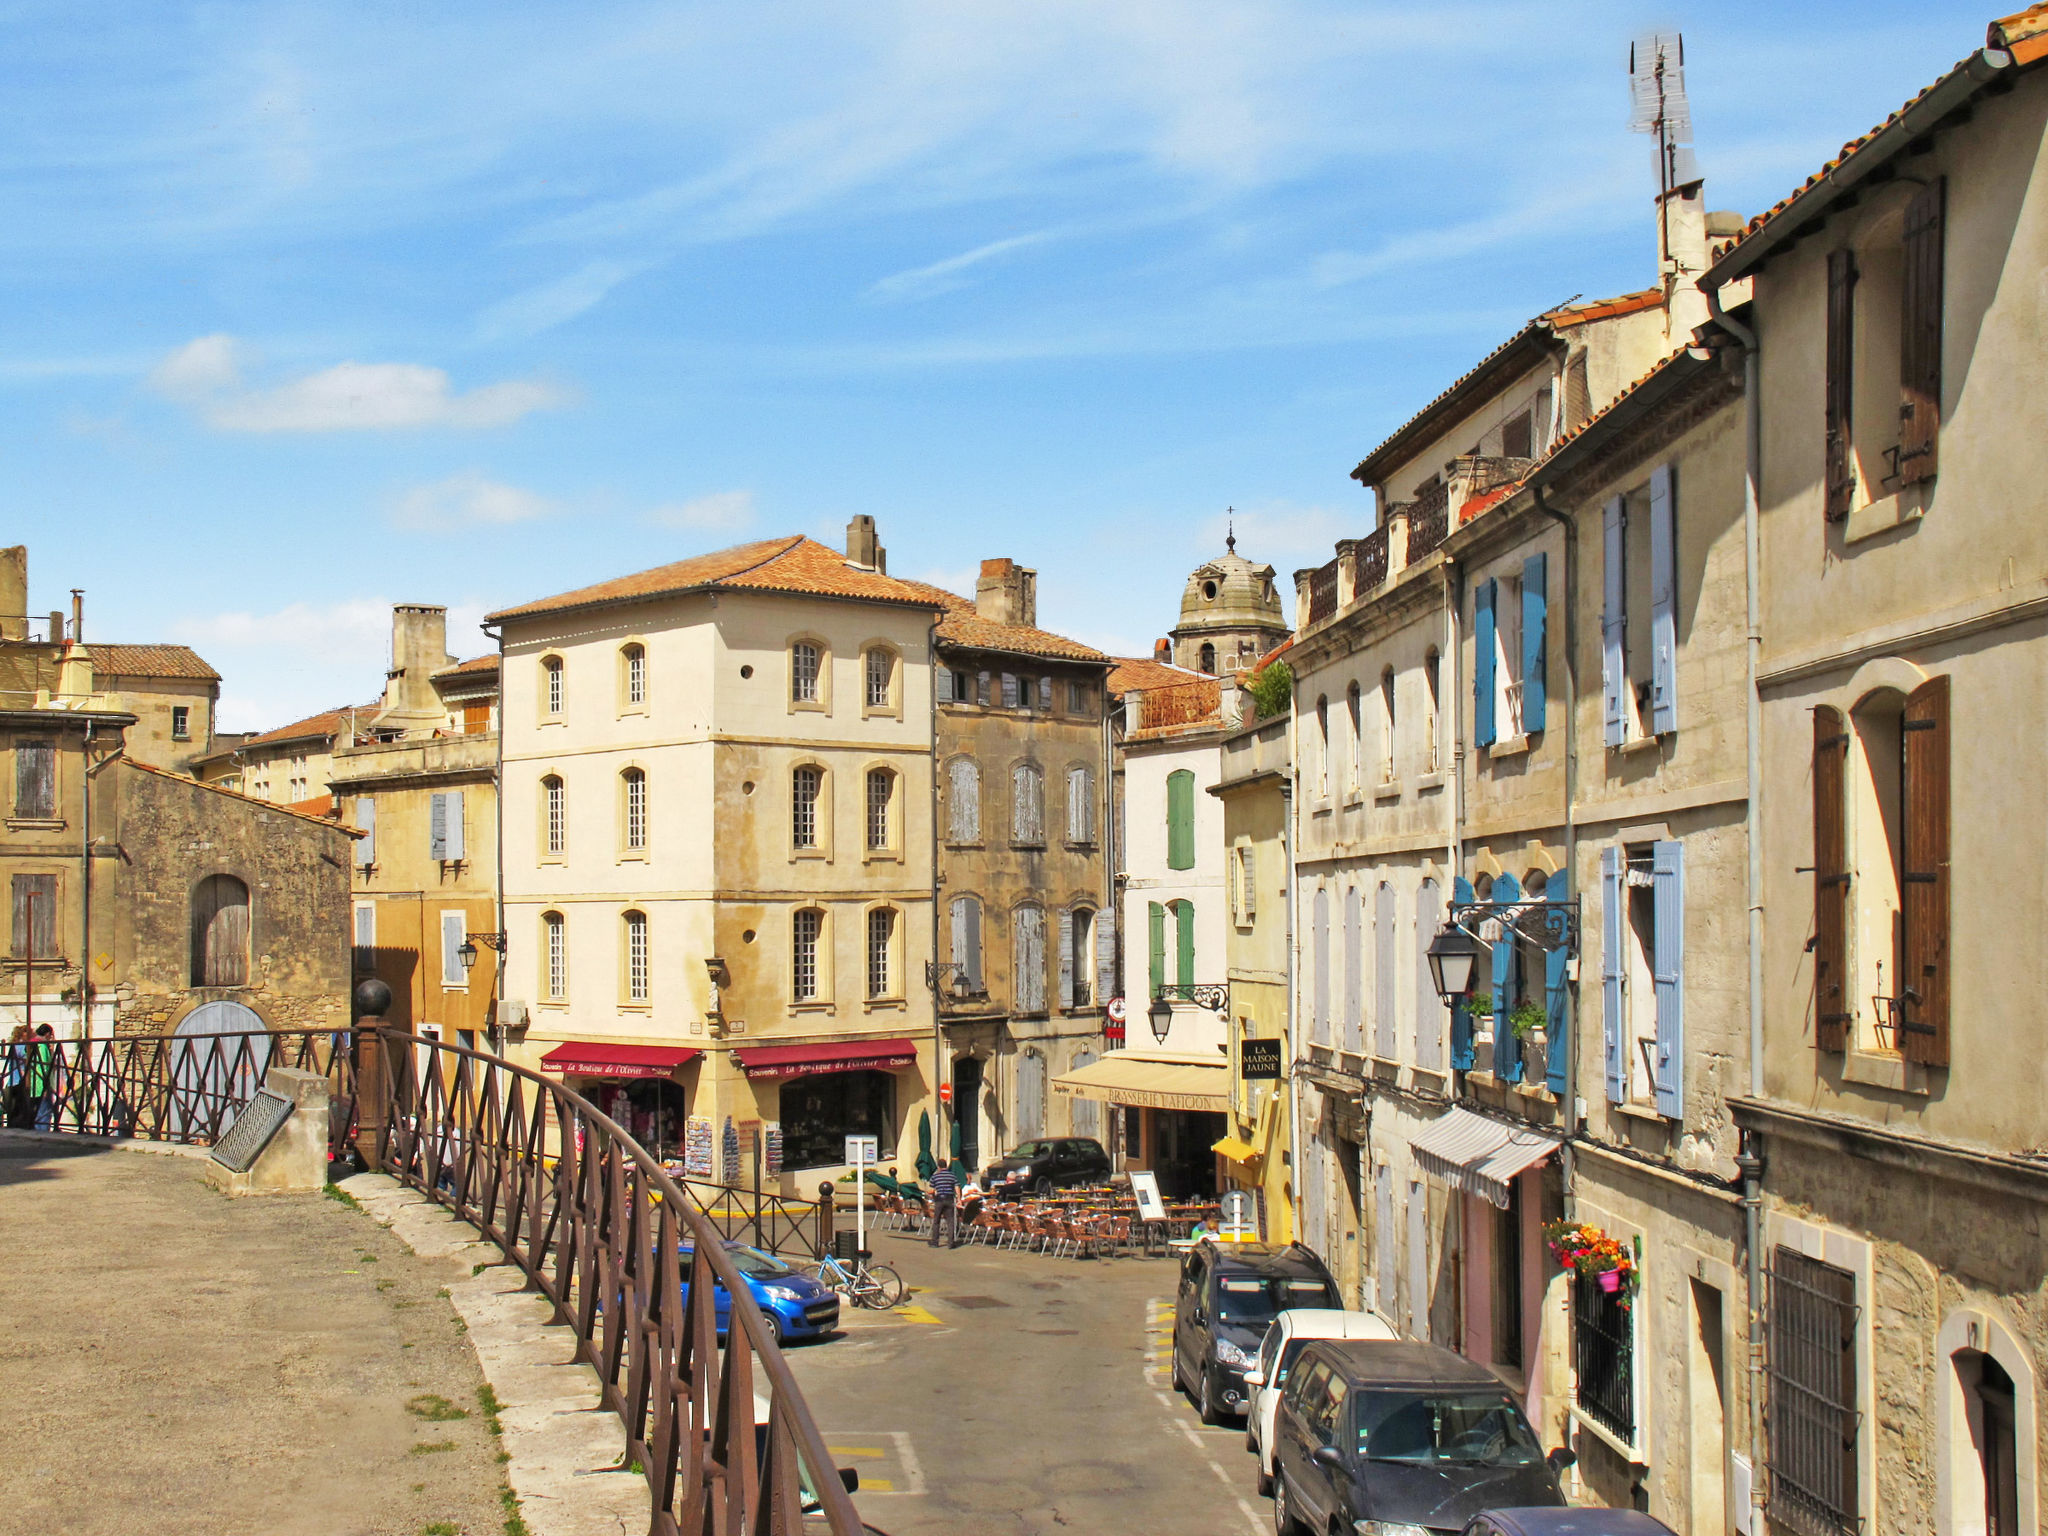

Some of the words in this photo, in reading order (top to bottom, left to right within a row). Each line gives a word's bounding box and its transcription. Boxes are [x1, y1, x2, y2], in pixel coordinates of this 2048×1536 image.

[1255, 1046, 1267, 1054] LA
[1243, 1054, 1279, 1063] MAISON
[567, 1063, 576, 1071] La
[578, 1063, 602, 1075] Boutique
[605, 1064, 614, 1073] de
[786, 1066, 795, 1074] La
[799, 1063, 831, 1073] Boutique
[1246, 1063, 1277, 1072] JAUNE
[1108, 1089, 1157, 1107] BRASSERIE
